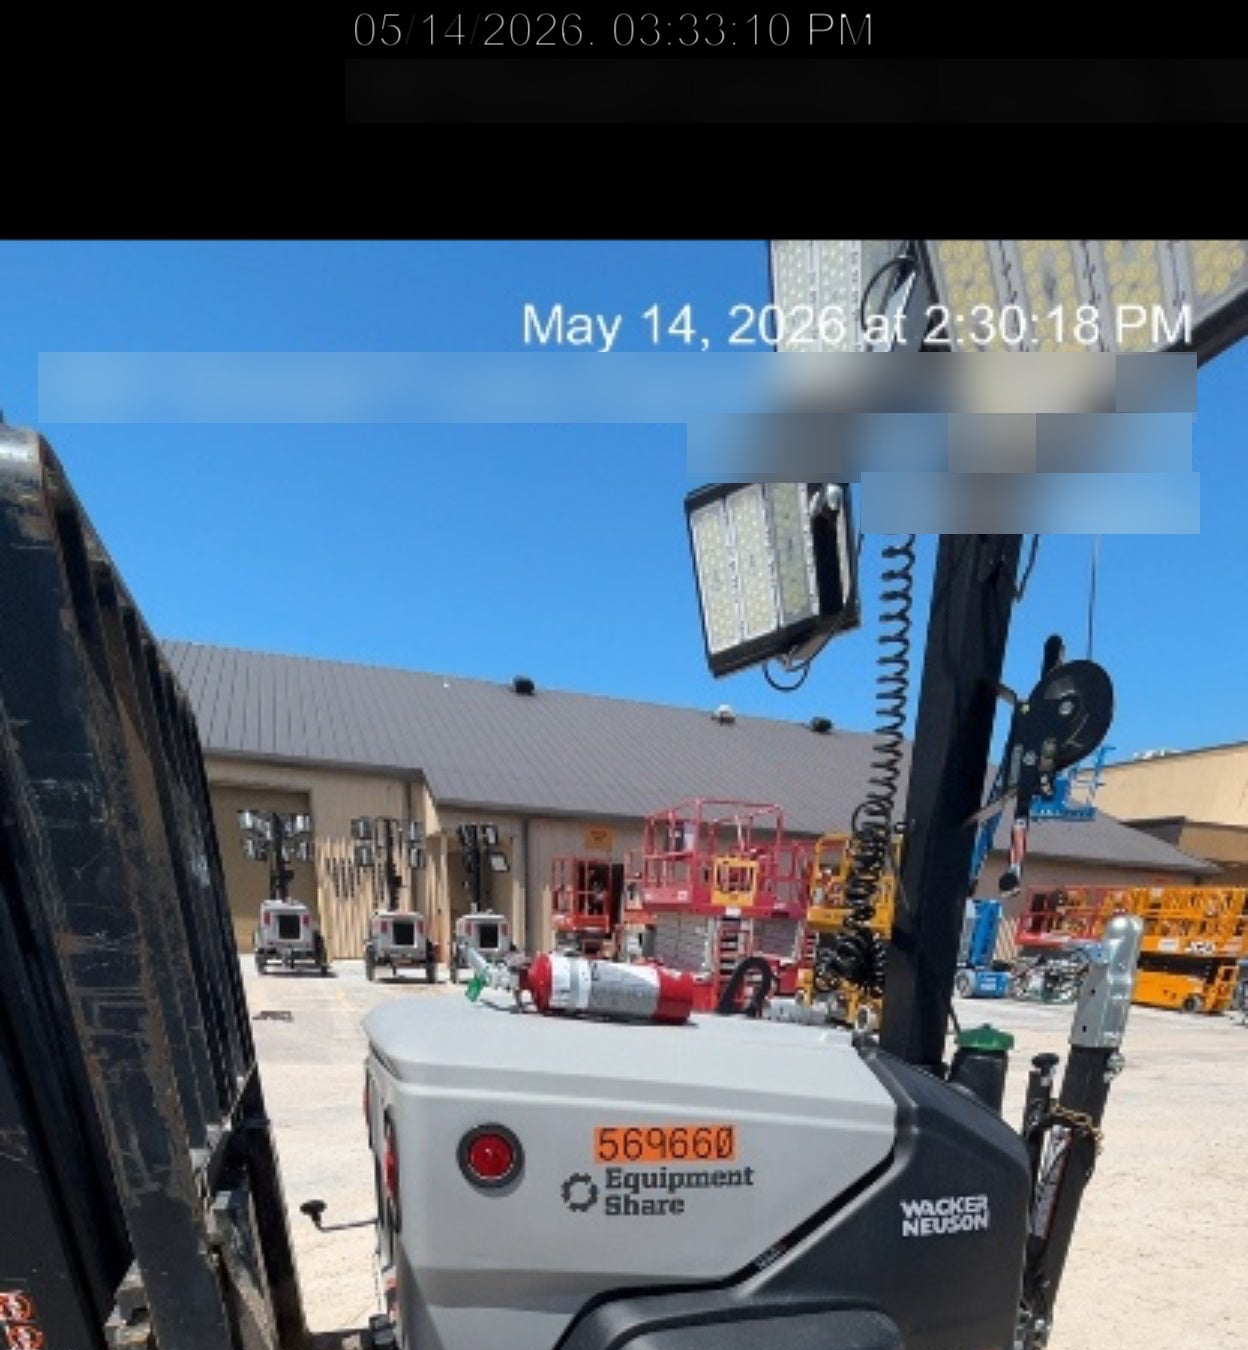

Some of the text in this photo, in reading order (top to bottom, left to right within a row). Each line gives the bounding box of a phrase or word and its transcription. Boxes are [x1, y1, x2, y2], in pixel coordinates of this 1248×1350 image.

[599, 1124, 735, 1161] 569660
[605, 1165, 755, 1195] Equipment
[604, 1193, 686, 1217] Share
[901, 1194, 988, 1219] WACKER
[902, 1211, 990, 1237] NEUSON
